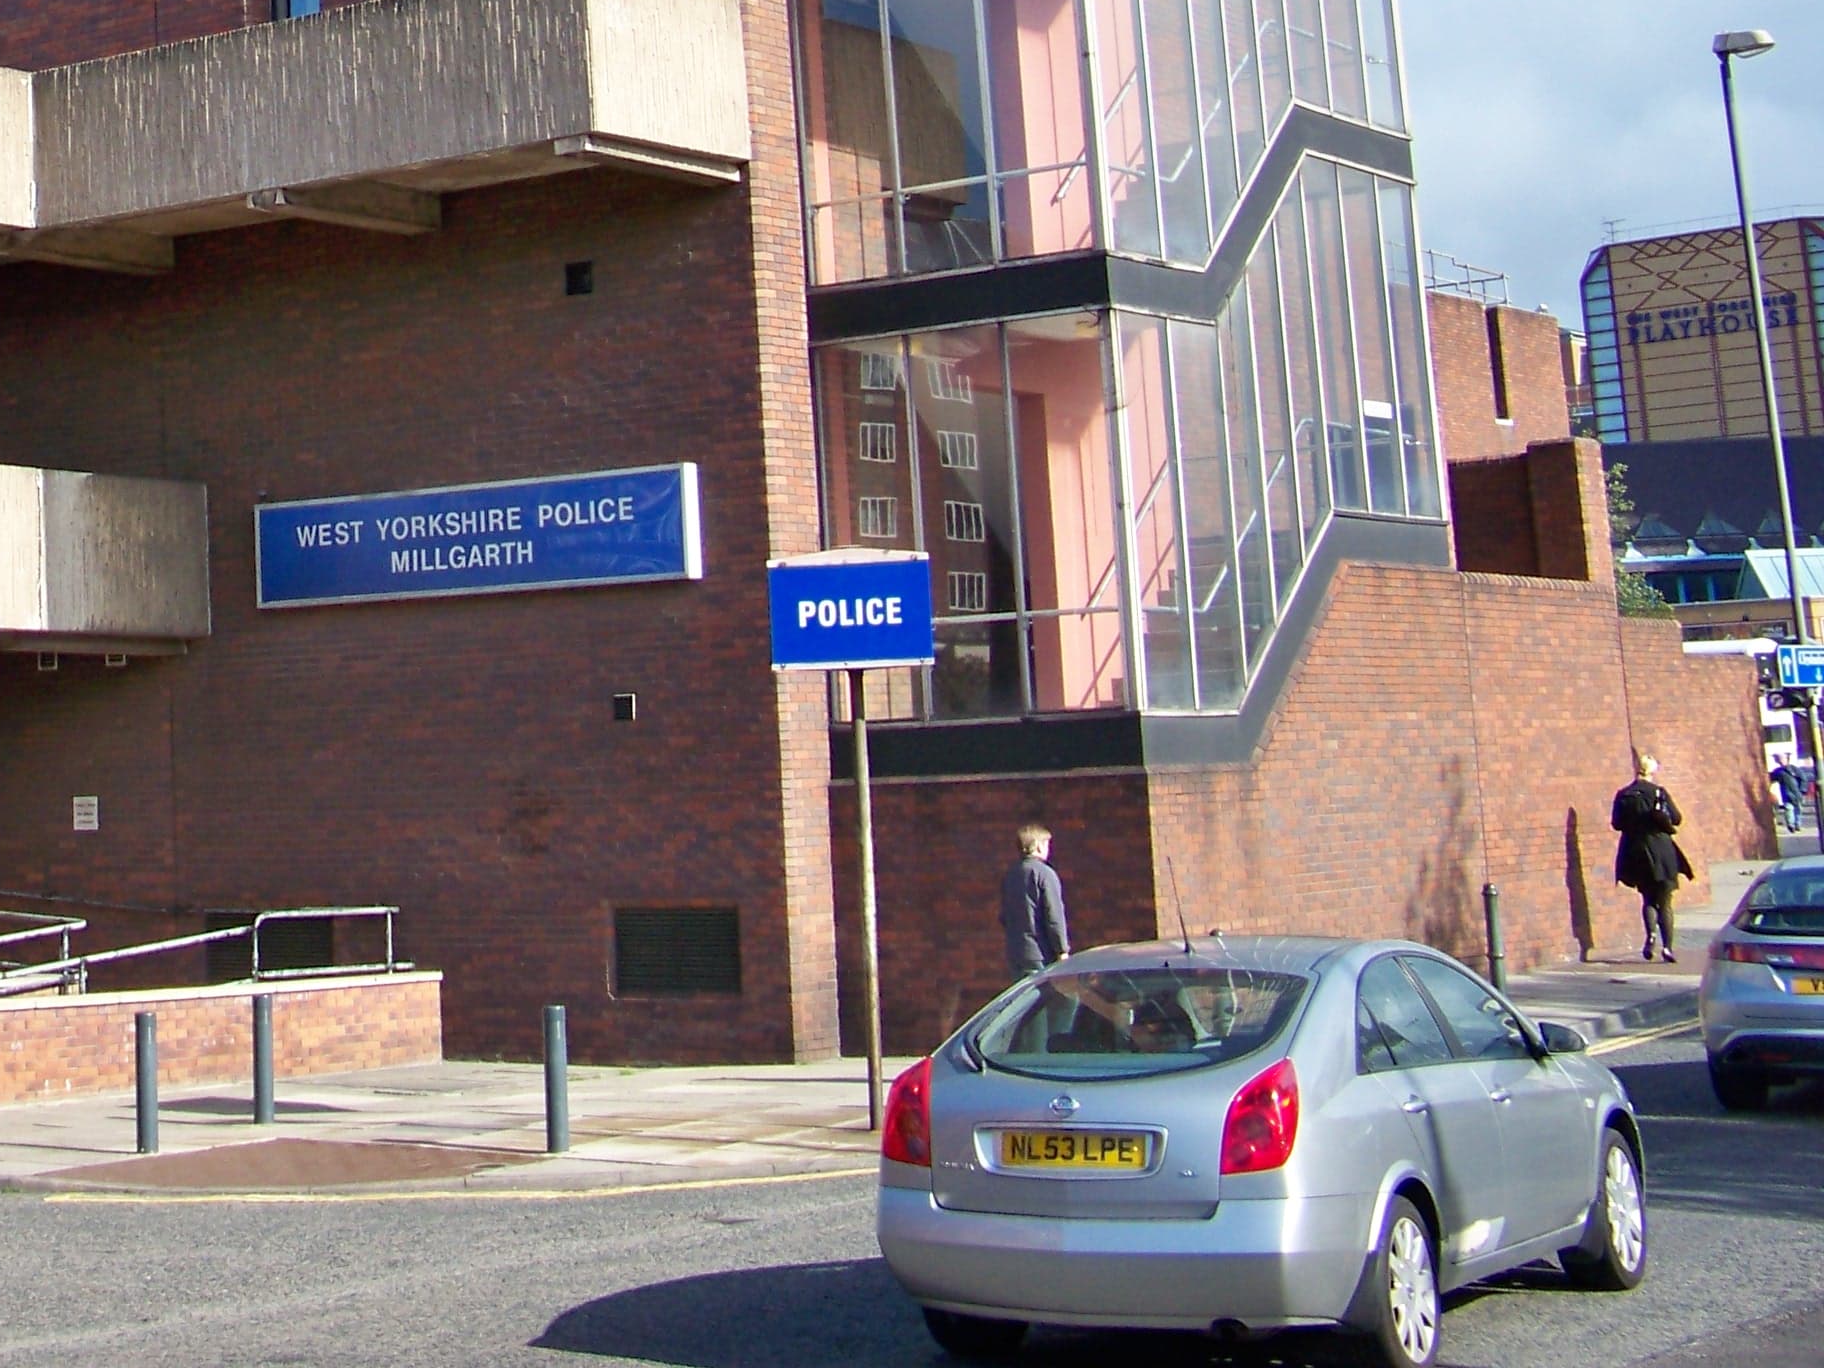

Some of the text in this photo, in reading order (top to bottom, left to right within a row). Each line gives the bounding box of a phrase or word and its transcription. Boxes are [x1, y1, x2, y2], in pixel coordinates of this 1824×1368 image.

[1660, 305, 1699, 320] WEST
[296, 496, 635, 548] WEST YORKSHIRE POLICE
[390, 539, 534, 574] MILLGARTH
[798, 597, 903, 629] POLICE
[1011, 1135, 1134, 1162] NL53 LPE
